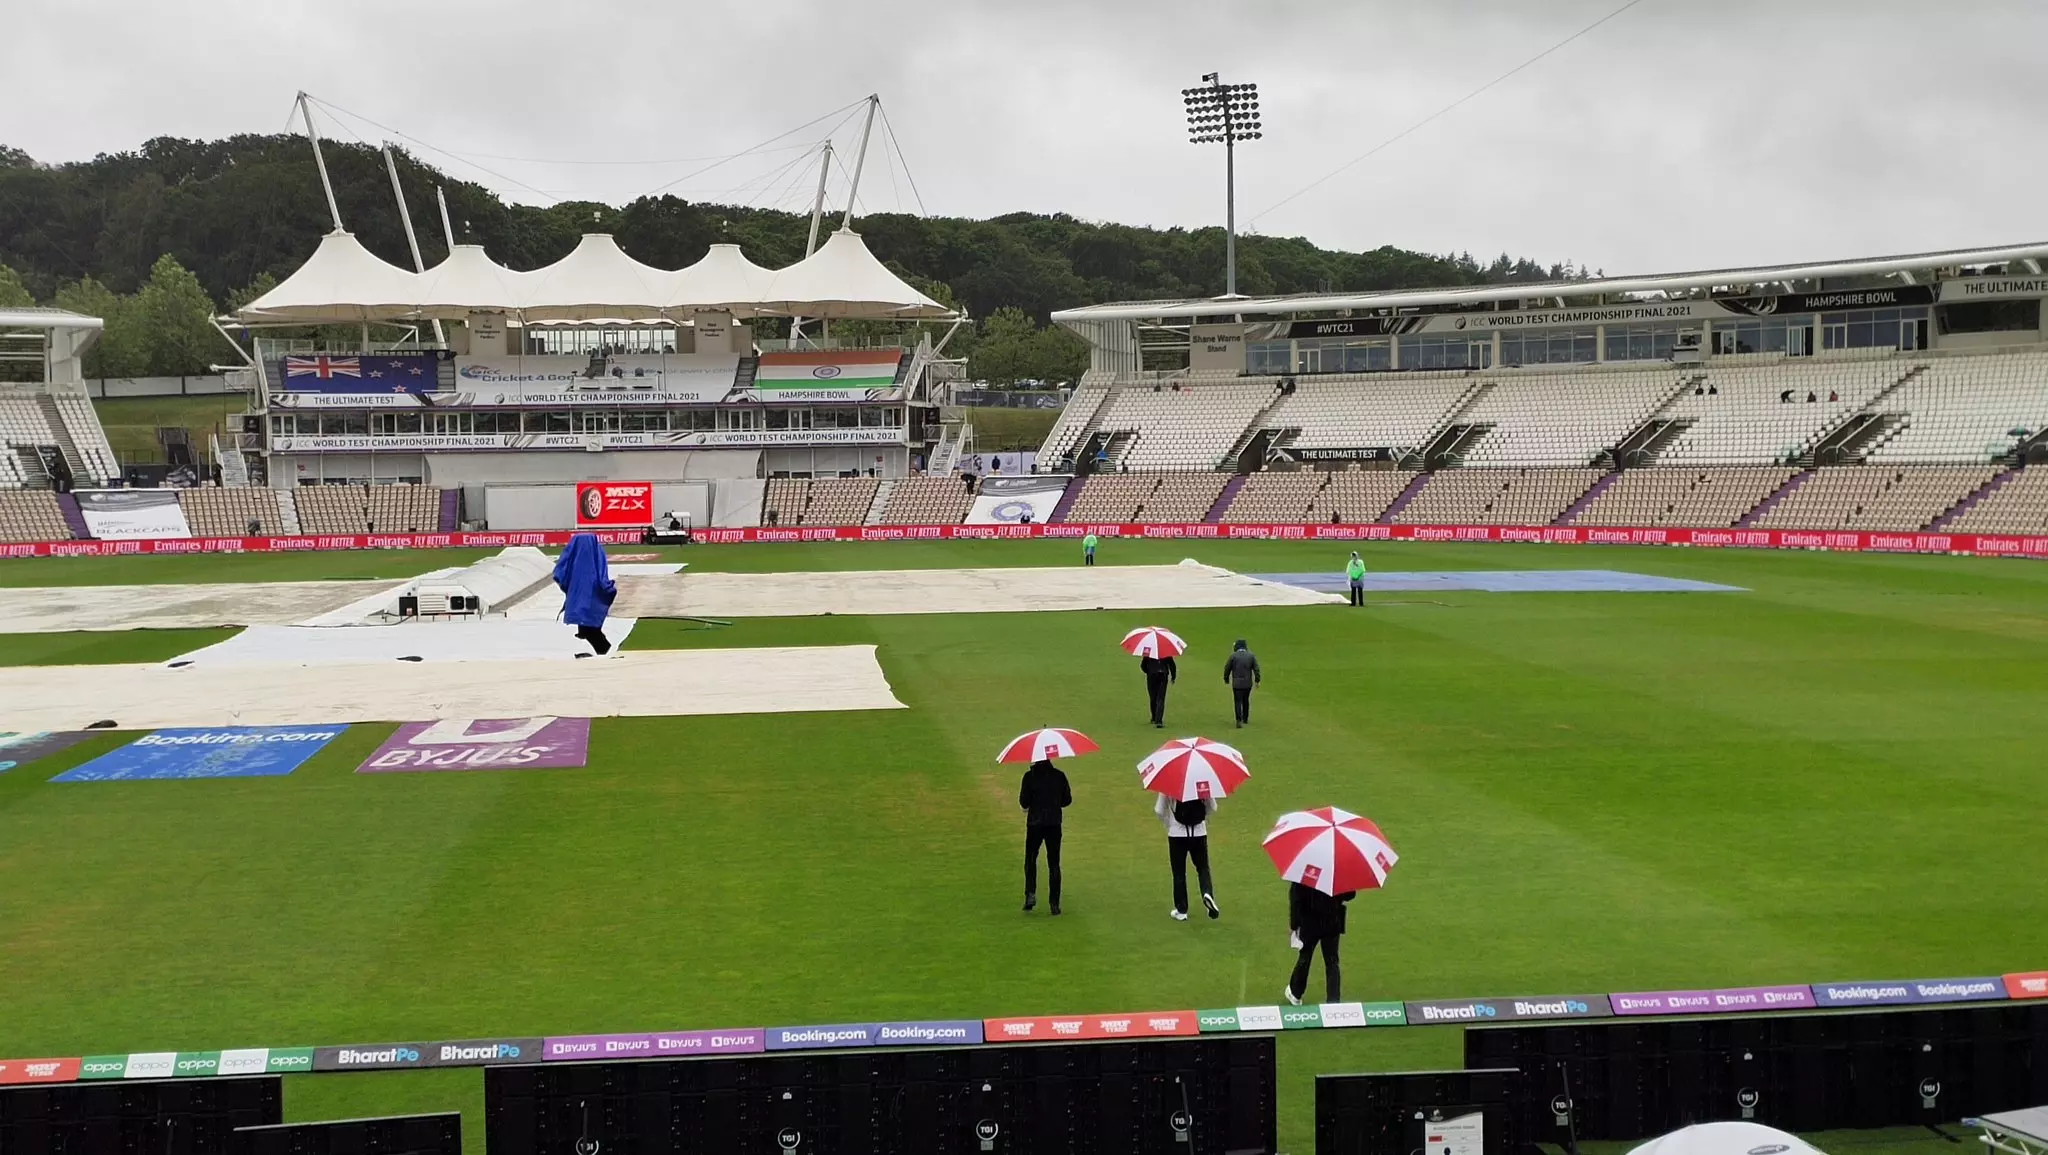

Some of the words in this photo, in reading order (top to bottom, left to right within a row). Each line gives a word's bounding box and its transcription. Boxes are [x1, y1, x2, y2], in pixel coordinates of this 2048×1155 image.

[1964, 283, 1985, 294] THE
[1805, 294, 1865, 308] HAMPSHIRE
[1866, 292, 1897, 304] BOWL
[1488, 316, 1524, 326] WORLD
[1526, 314, 1549, 324] TEST
[1551, 308, 1633, 322] CHAMPIONSHIP
[1635, 307, 1666, 319] FINAL
[1667, 306, 1692, 317] 2021
[1317, 323, 1354, 333] #WTC21
[1192, 335, 1216, 343] Shane
[482, 374, 534, 382] Cricket
[314, 396, 331, 405] THE
[332, 396, 373, 405] ULTIMATE
[375, 396, 395, 404] TEST
[524, 394, 556, 402] WORLD
[559, 394, 578, 402] TEST
[581, 393, 651, 401] CHAMPIONSHIP
[652, 393, 678, 401] FINAL
[779, 391, 826, 399] HAMPSHIRE
[826, 391, 850, 399] BOWL
[313, 439, 346, 447] WORLD
[349, 439, 369, 447] TEST
[372, 438, 445, 447] CHAMPIONSHIP
[446, 438, 473, 446] FINAL
[546, 437, 579, 445] #WTC21
[610, 436, 643, 444] #WTC21
[725, 434, 756, 442] WORLD
[759, 433, 779, 441] TEST
[780, 432, 849, 441] CHAMPIONSHIP
[850, 432, 876, 440] FINAL
[876, 432, 897, 440] 2021
[1301, 450, 1317, 459] THE
[1319, 450, 1357, 459] ULTIMATE
[1358, 450, 1378, 459] TEST
[605, 487, 649, 497] MRF
[607, 499, 646, 511] ZLX
[757, 530, 799, 540] Emirates
[861, 527, 903, 538] Emirates
[953, 526, 995, 537] Emirates
[1043, 525, 1084, 536] Emirates
[1143, 525, 1183, 536] Emirates
[1229, 525, 1270, 537] Emirates
[1316, 526, 1356, 537] Emirates
[1414, 526, 1453, 538] Emirates
[1500, 528, 1541, 540] Emirates
[1588, 529, 1629, 541] Emirates
[367, 536, 411, 547] Emirates
[463, 535, 506, 545] Emirates
[1691, 530, 1732, 543] Emirates
[1781, 532, 1822, 545] Emirates
[1870, 534, 1913, 548] Emirates
[50, 543, 98, 555] Emirates
[154, 541, 201, 552] Emirates
[270, 538, 315, 549] Emirates
[1977, 537, 2019, 551] Emirates
[1828, 986, 1907, 1000] Booking.com
[1917, 982, 1996, 997] Booking.com
[1423, 1003, 1496, 1020] BharatPe
[1514, 1000, 1588, 1016] BharatPe
[1200, 1016, 1236, 1027] oppo
[1284, 1011, 1319, 1023] oppo
[1367, 1009, 1402, 1020] oppo
[782, 1028, 867, 1044] Booking.com
[881, 1026, 966, 1042] Booking.com
[565, 1043, 597, 1053] BYJU'S
[618, 1040, 650, 1051] BYJU'S
[670, 1038, 702, 1049] BYJU'S
[723, 1036, 755, 1046] BYJU'S
[338, 1048, 419, 1064] BharatPe
[440, 1044, 521, 1061] BharatPe
[84, 1062, 123, 1073] oppo
[131, 1061, 170, 1071] oppo
[178, 1059, 216, 1071] oppo
[223, 1057, 262, 1068] oppo
[270, 1055, 309, 1067] oppo
[1741, 1093, 1754, 1102] TGI
[980, 1126, 993, 1134] TGI
[781, 1135, 795, 1143] TGI
